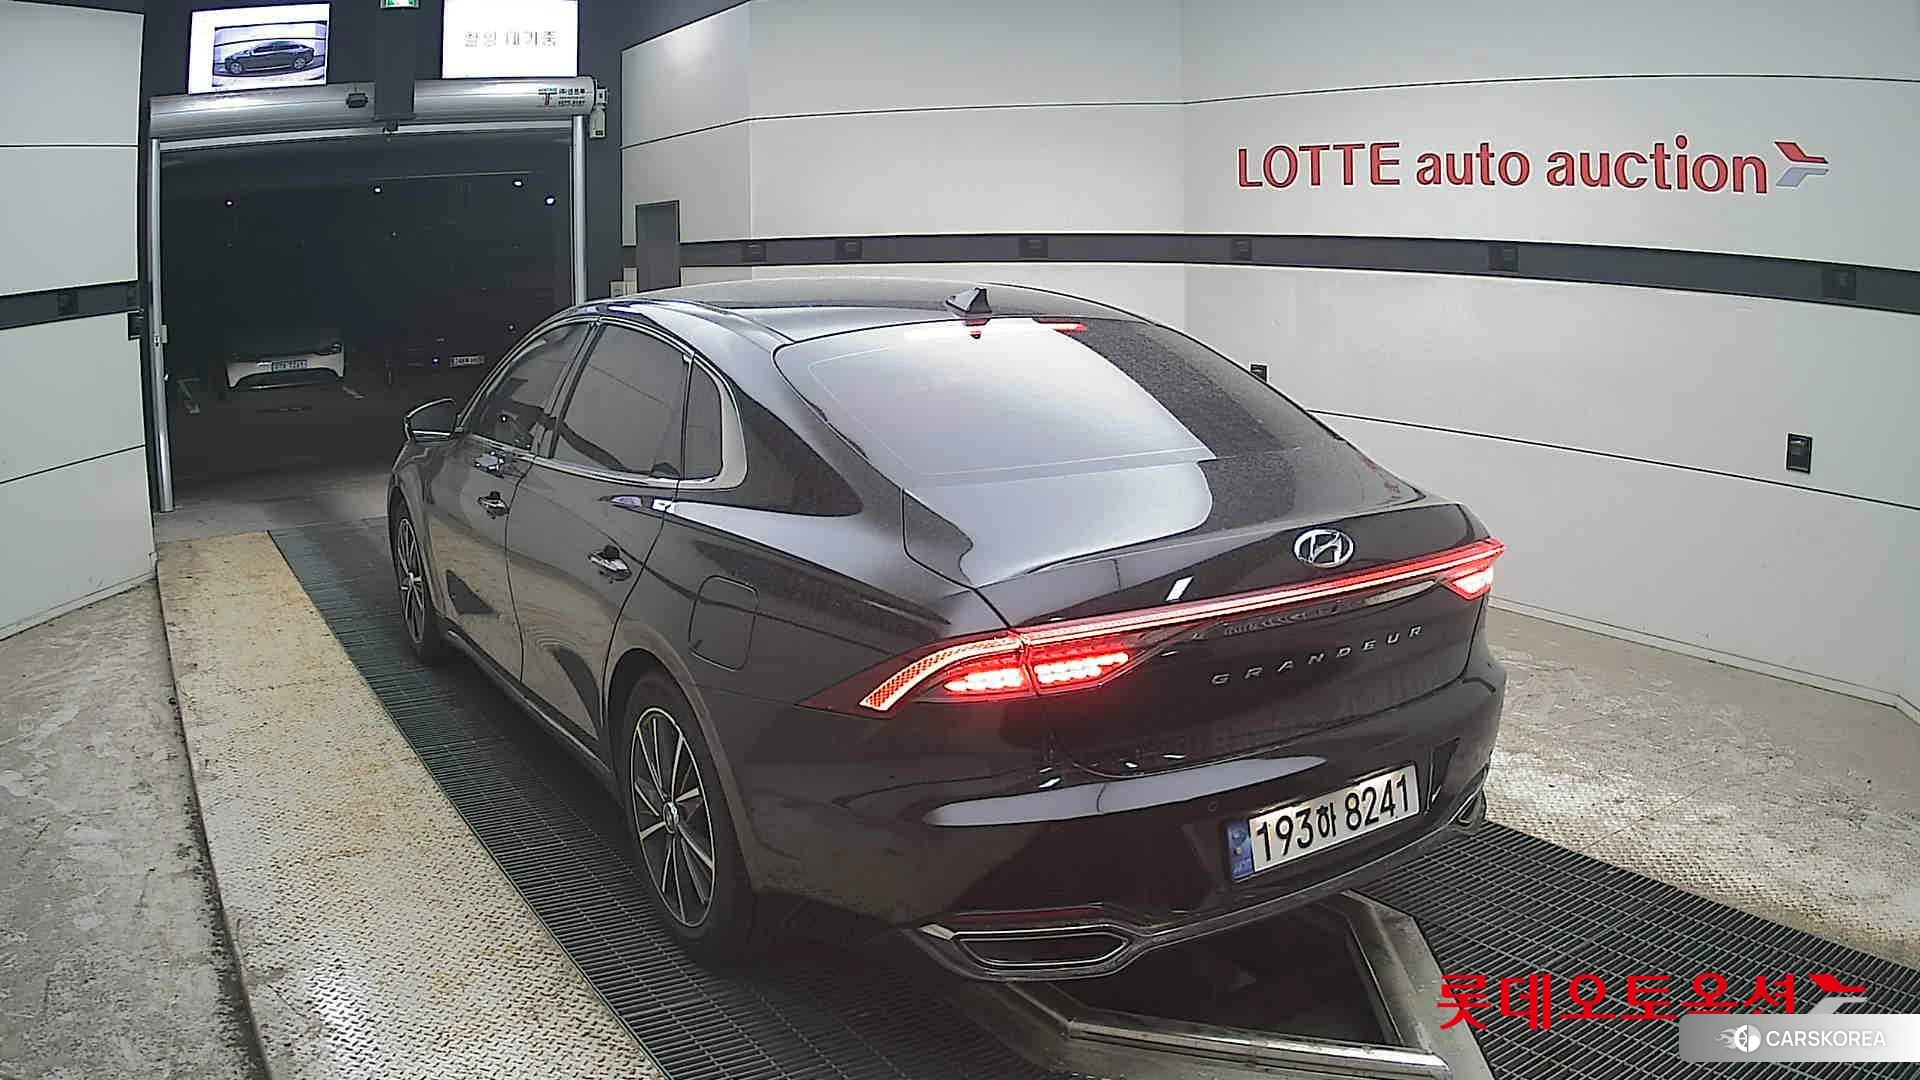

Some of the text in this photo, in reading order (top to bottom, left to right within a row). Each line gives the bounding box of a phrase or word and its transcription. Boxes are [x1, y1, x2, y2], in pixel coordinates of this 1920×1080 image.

[1238, 135, 1767, 193] LOTTE auto auction
[1211, 625, 1422, 685] GRANDEUR
[1256, 774, 1409, 862] 193하 8241
